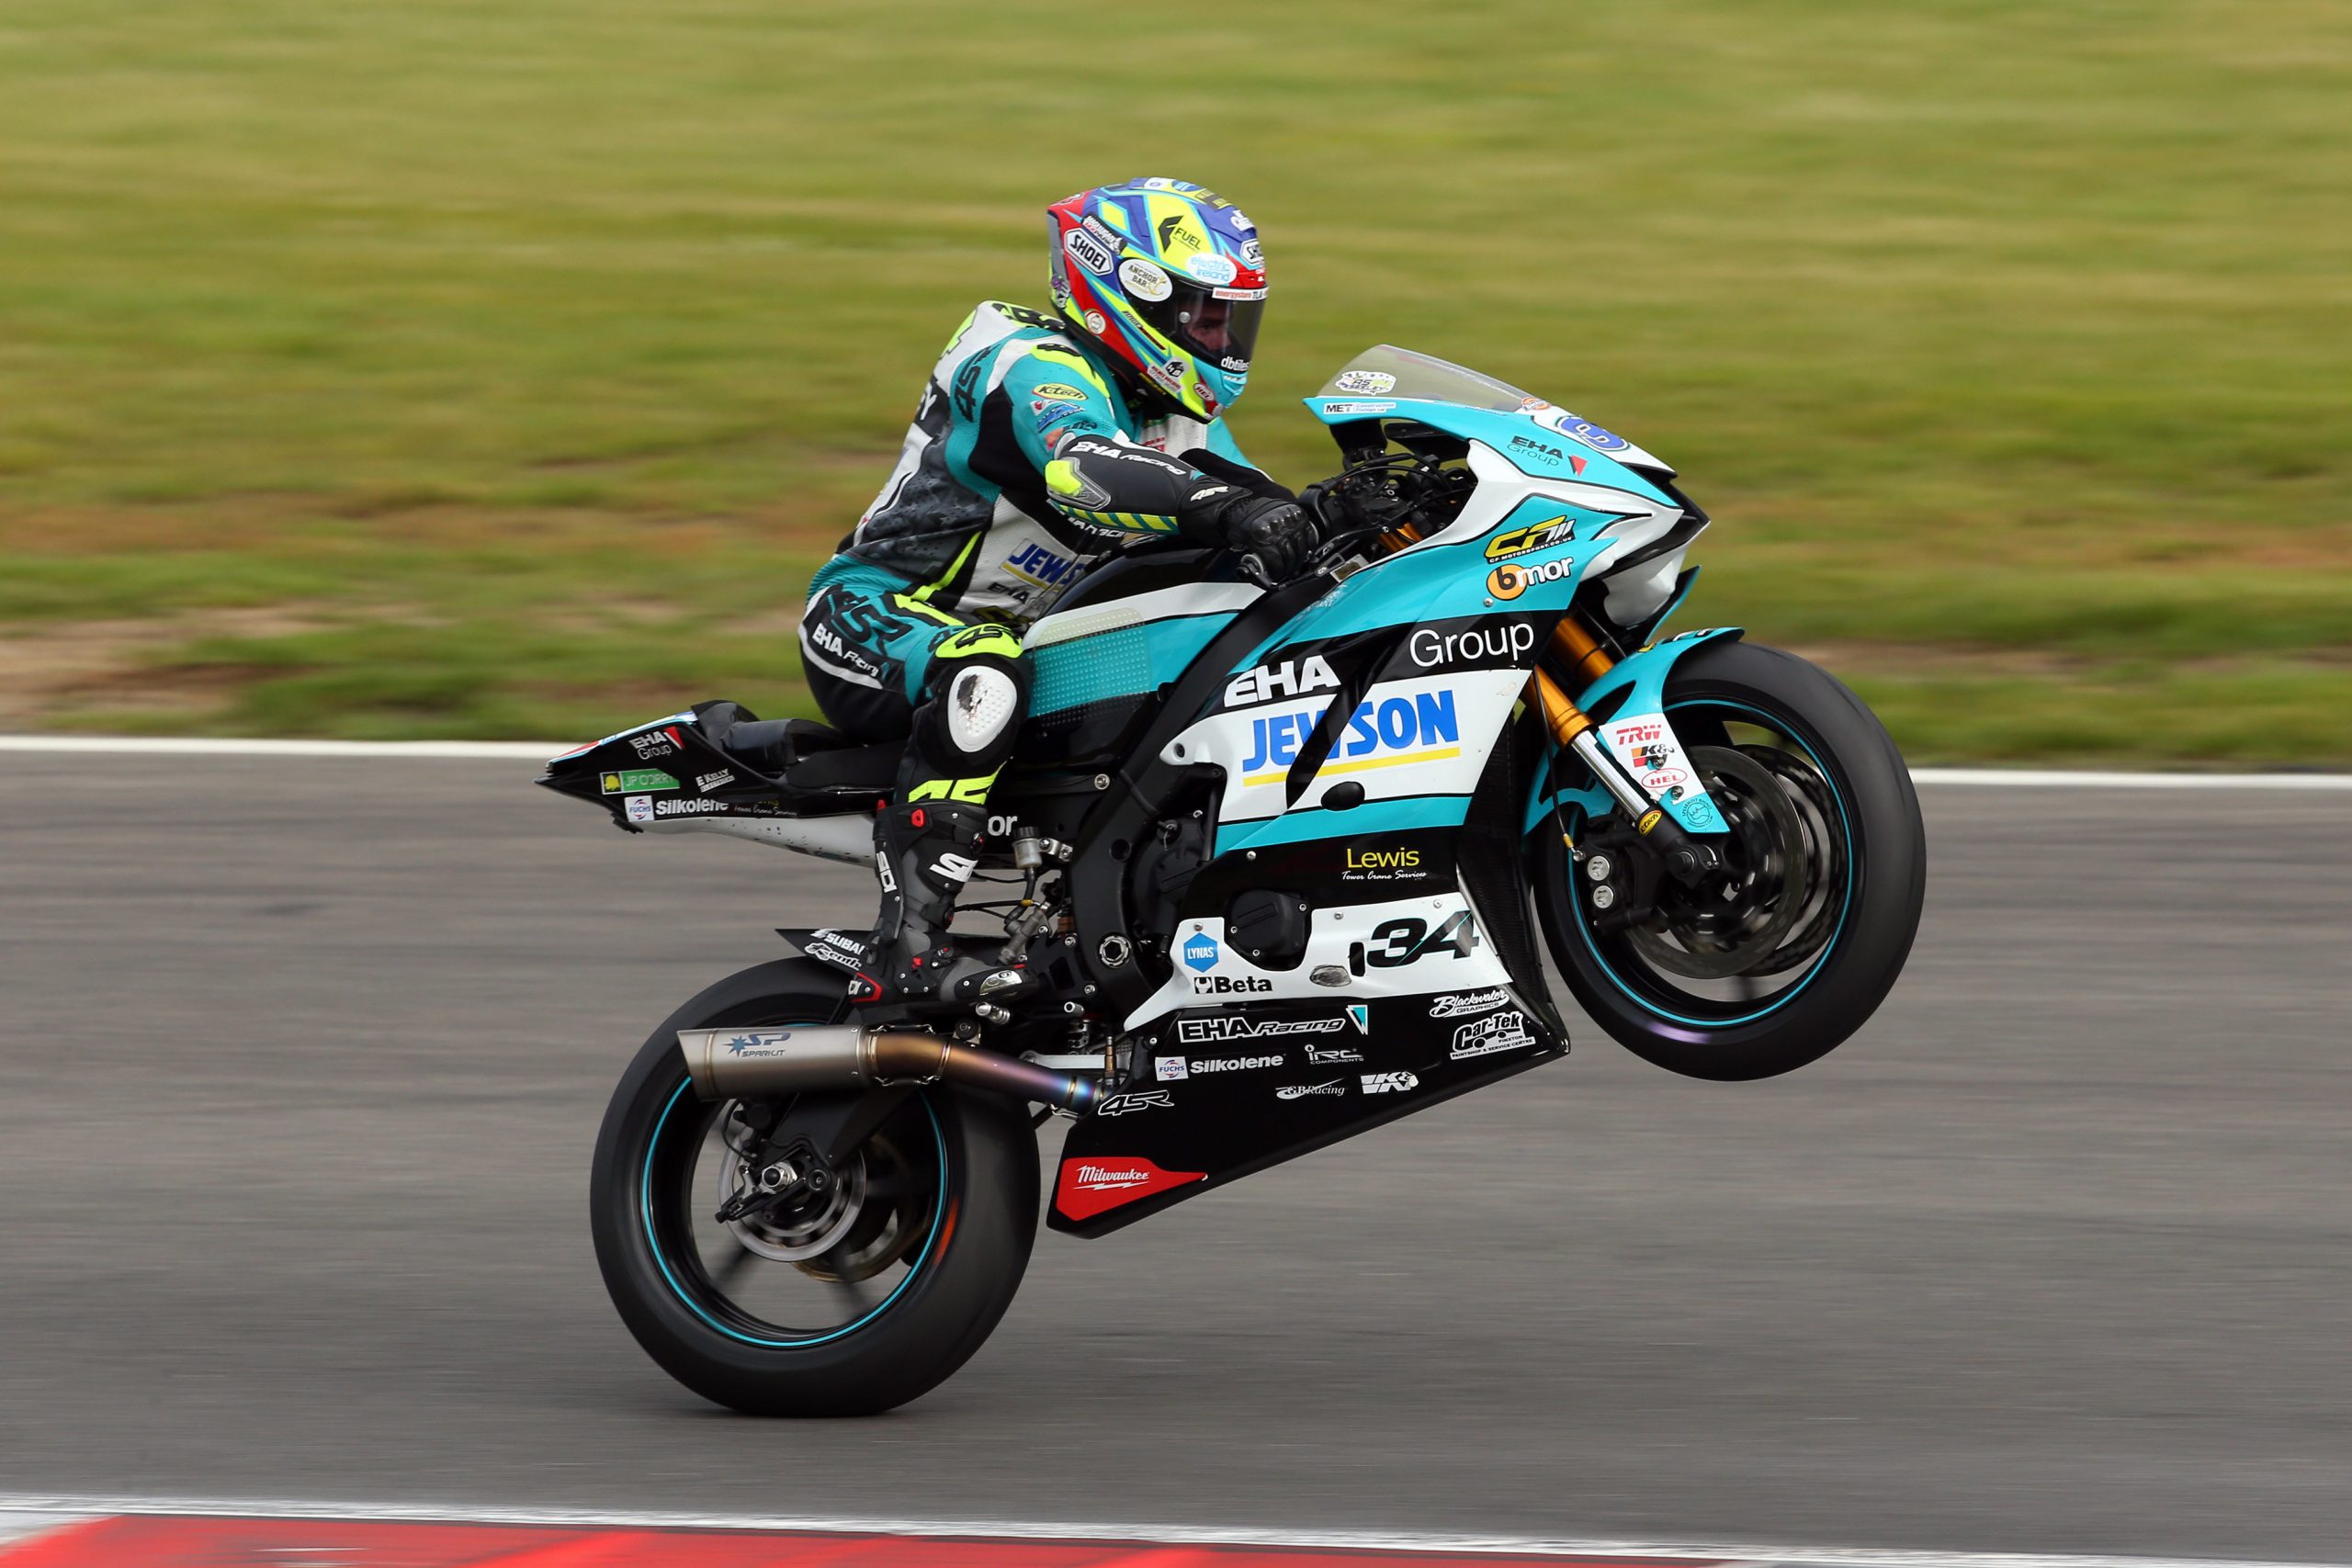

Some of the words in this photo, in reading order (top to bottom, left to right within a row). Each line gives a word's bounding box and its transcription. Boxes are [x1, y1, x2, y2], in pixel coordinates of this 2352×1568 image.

[1175, 228, 1201, 250] FUEL
[1070, 234, 1106, 270] SHOEI
[1128, 265, 1159, 284] ANCHOR
[1131, 275, 1148, 288] BAR
[1195, 386, 1210, 399] HEL
[1326, 404, 1352, 413] MET
[1507, 444, 1559, 467] Group
[1511, 435, 1564, 458] EHA
[1069, 441, 1122, 459] EHA
[1119, 454, 1187, 476] Racing
[1496, 557, 1574, 591] bmor
[812, 623, 843, 658] EHA
[1224, 654, 1341, 708] EHA
[1409, 623, 1534, 668] Group
[628, 731, 667, 749] EHA
[1616, 724, 1661, 745] TRW
[638, 744, 672, 760] Group
[695, 776, 705, 786] E
[1650, 774, 1680, 785] HEL
[656, 797, 729, 815] Silkolene
[988, 816, 1018, 837] or
[1347, 847, 1419, 868] Lewis
[1341, 870, 1365, 880] Tower
[1367, 870, 1392, 880] Crane
[1395, 869, 1428, 880] Services
[1366, 910, 1479, 968] 34
[1187, 946, 1215, 960] LYNAS
[1214, 976, 1272, 993] Beta
[1430, 989, 1508, 1017] Blackwater
[1456, 1002, 1499, 1013] GRAPHICS
[749, 1032, 791, 1045] SP
[1178, 1017, 1254, 1043] EHA
[1253, 1018, 1346, 1035] Racing
[1453, 1012, 1522, 1050] Car-Tek
[1452, 1049, 1481, 1058] PAINTSHOP
[1488, 1043, 1510, 1052] SERVICE
[1511, 1039, 1532, 1047] CENTRE
[1191, 1055, 1283, 1073] Silkolene
[1286, 1084, 1346, 1097] GBRacing
[1367, 1071, 1419, 1094] K&N
[1077, 1165, 1149, 1183] Milwaukee
